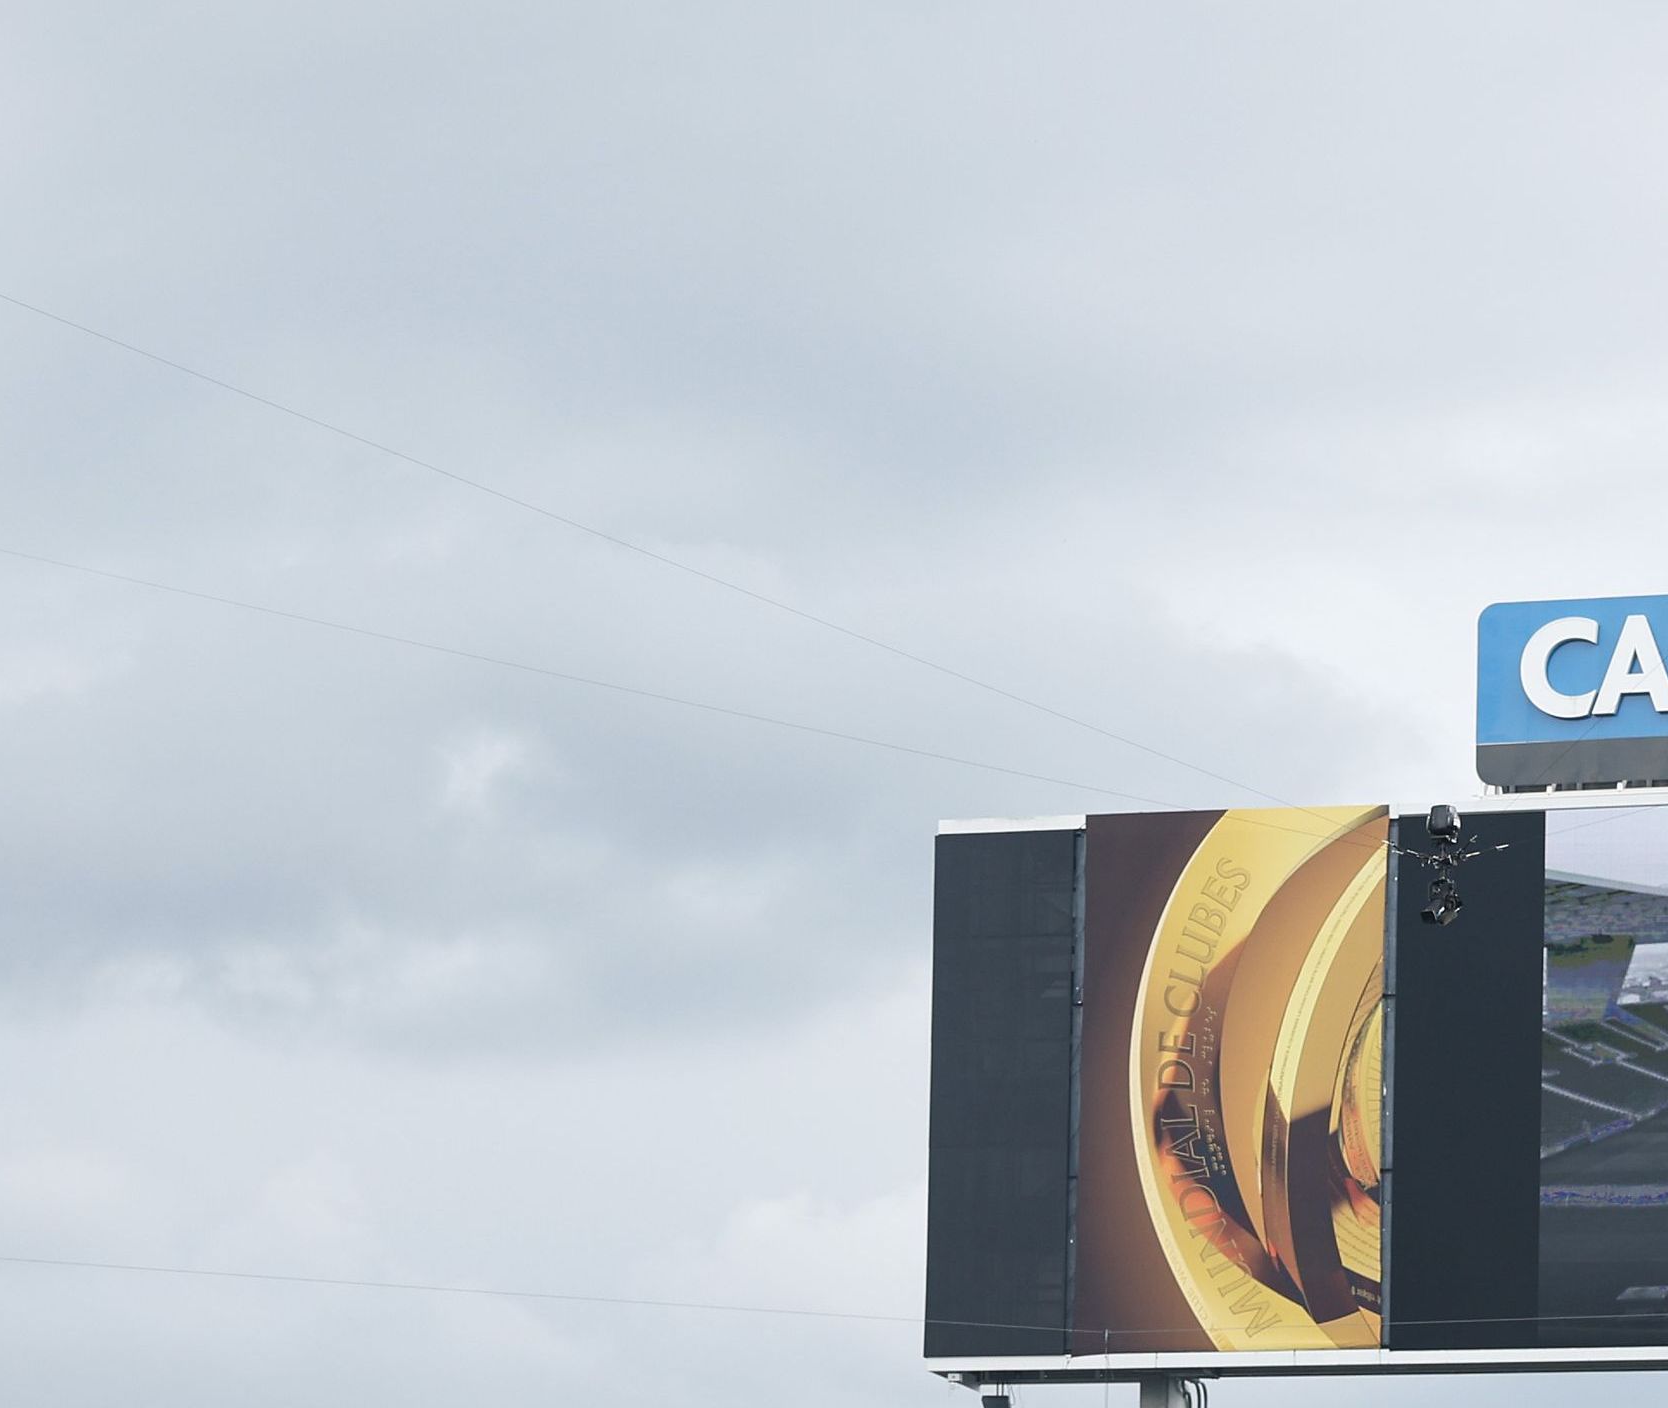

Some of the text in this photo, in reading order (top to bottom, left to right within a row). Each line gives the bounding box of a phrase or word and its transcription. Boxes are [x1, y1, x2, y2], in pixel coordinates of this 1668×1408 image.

[1163, 855, 1253, 1019] CLUBES
[1156, 1030, 1198, 1094] DE
[1161, 1102, 1283, 1339] MUNDIAL
